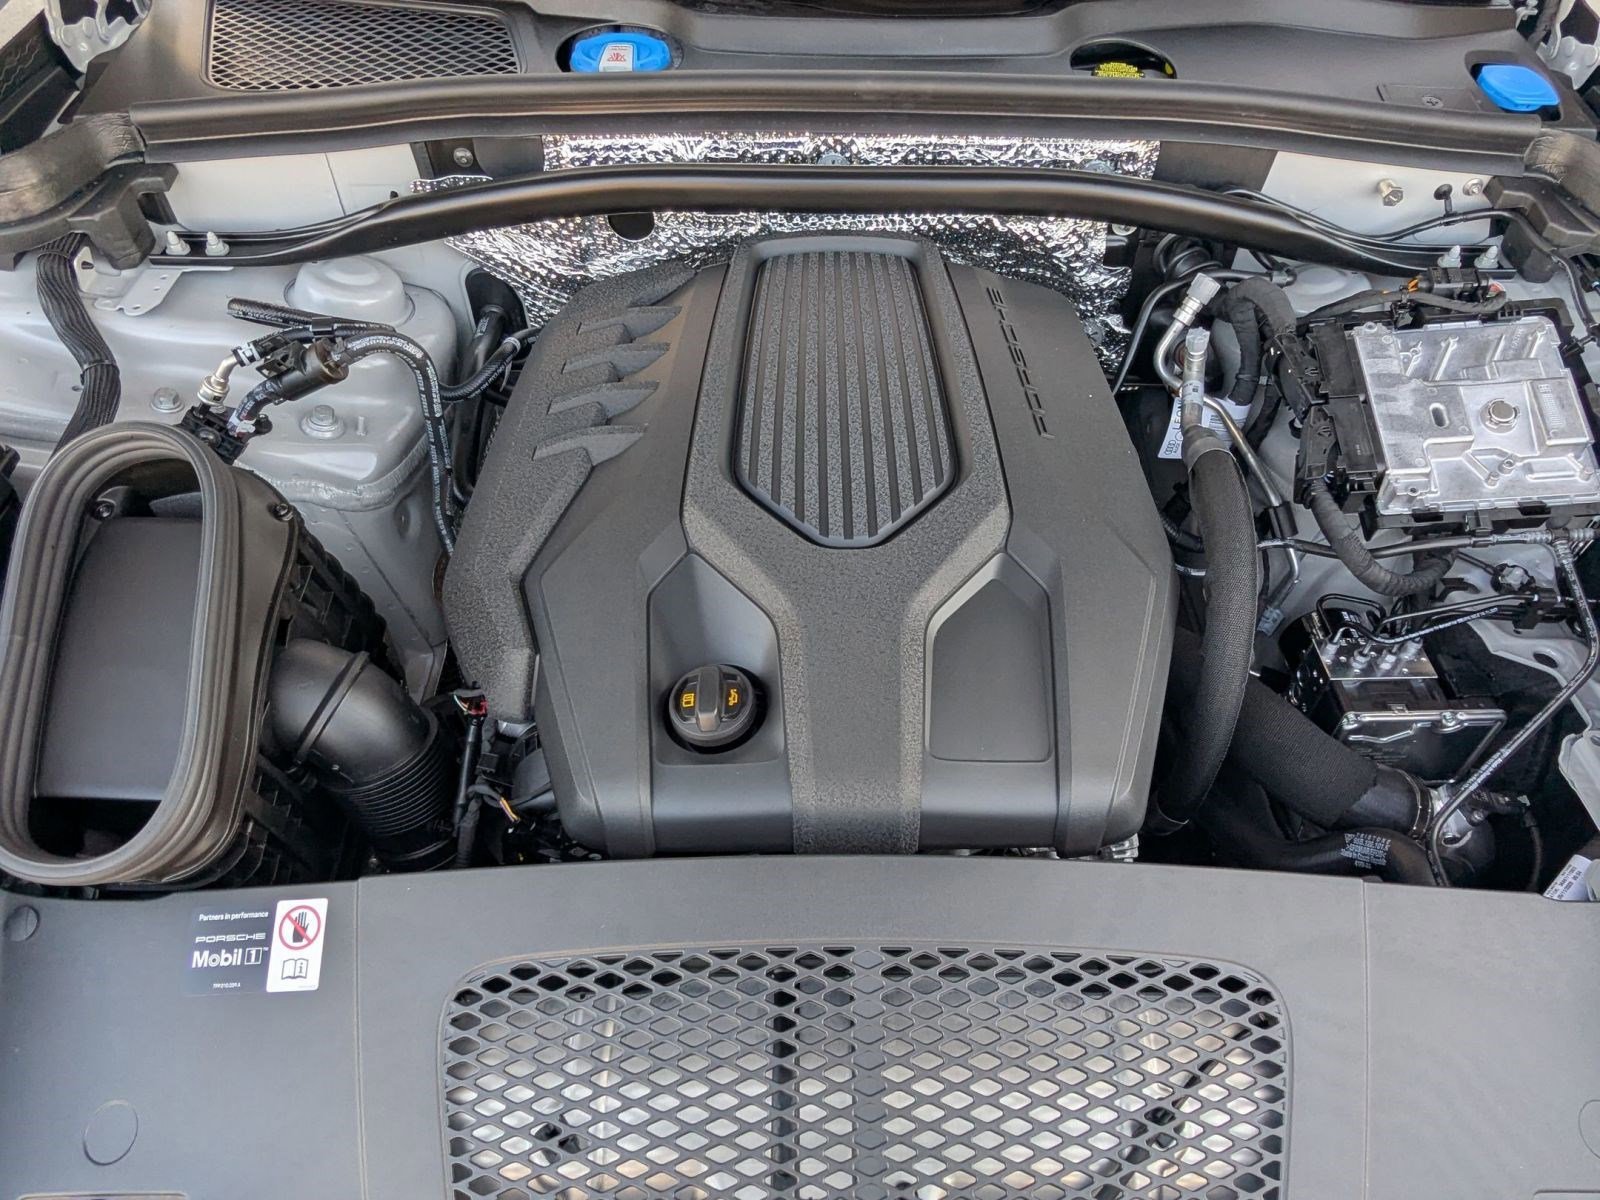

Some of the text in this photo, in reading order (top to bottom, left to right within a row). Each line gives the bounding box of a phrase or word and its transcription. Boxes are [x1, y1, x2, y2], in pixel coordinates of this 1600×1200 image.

[986, 286, 1056, 440] PORSCHE
[231, 911, 269, 920] performance
[195, 932, 266, 943] PORSCHE
[191, 948, 243, 968] Mobil
